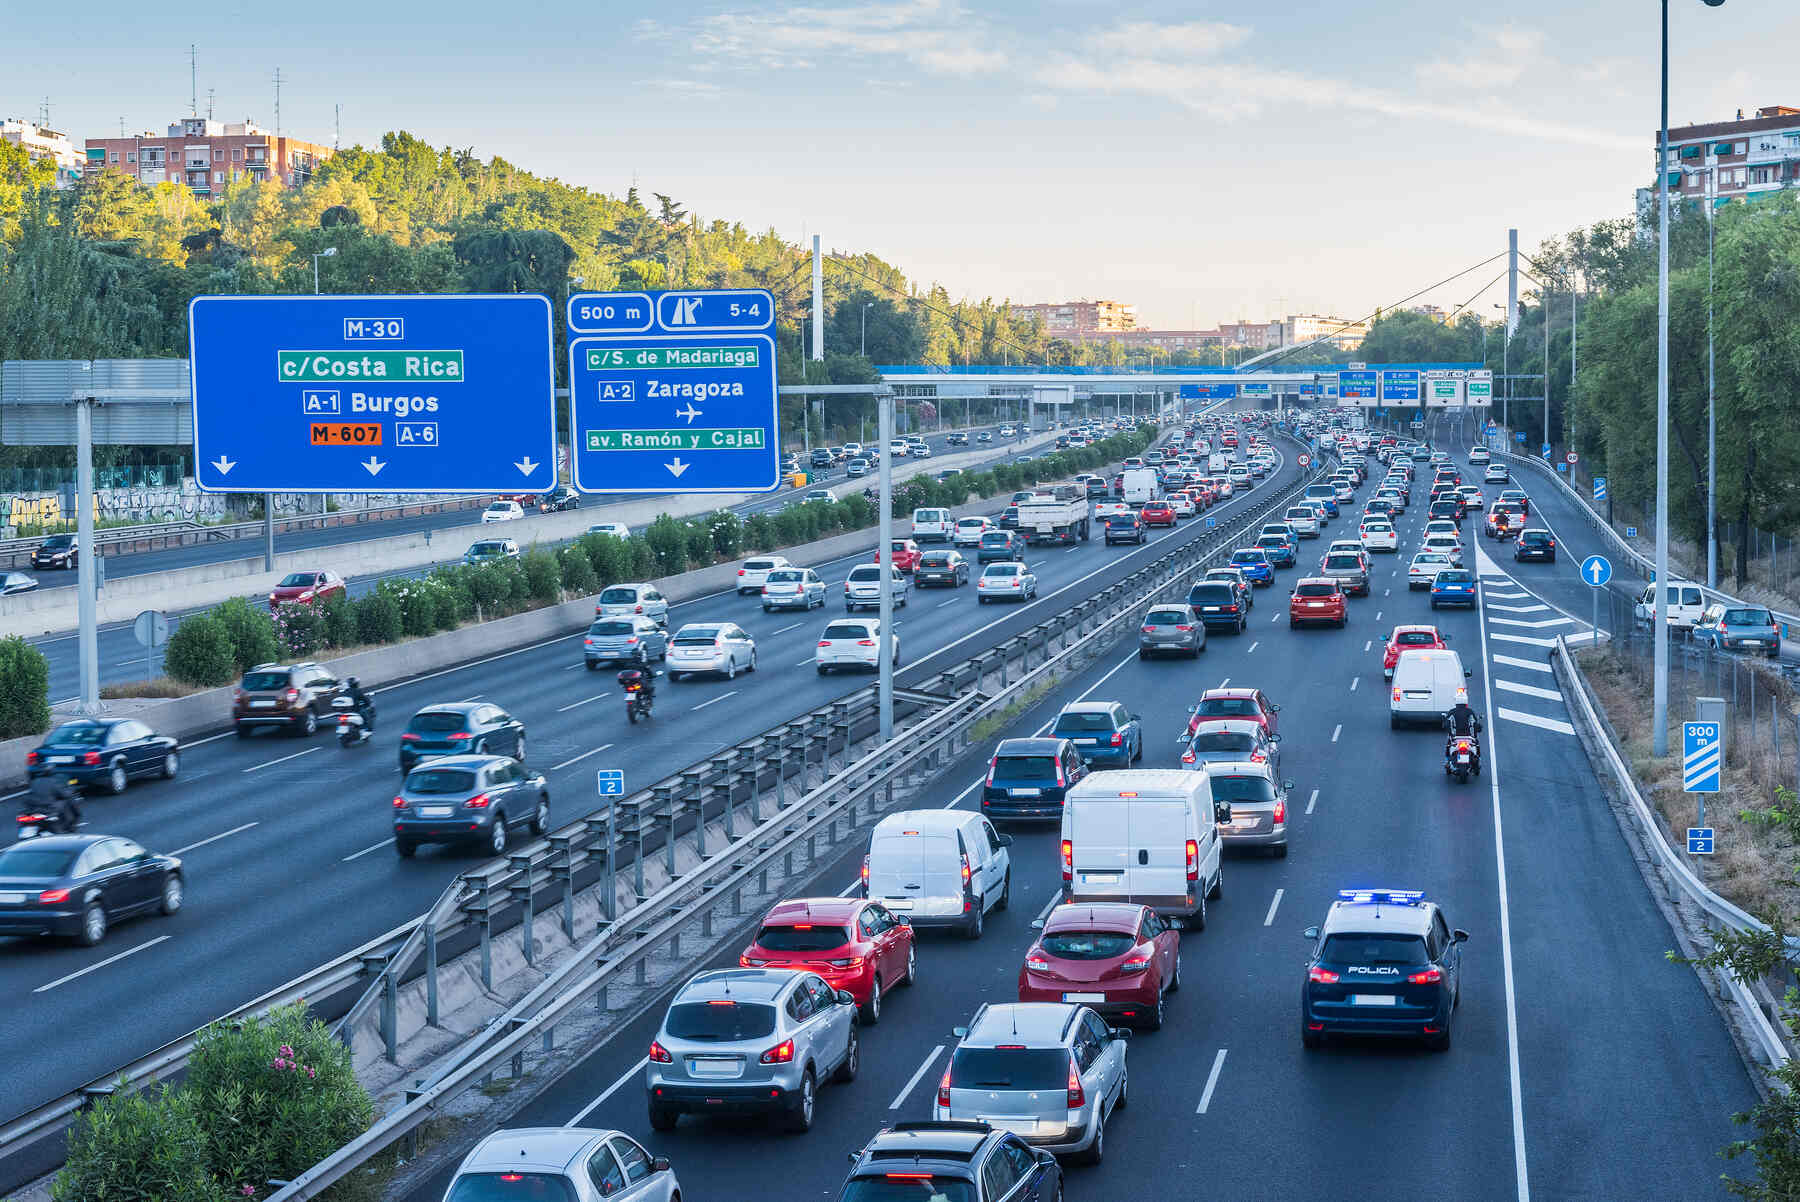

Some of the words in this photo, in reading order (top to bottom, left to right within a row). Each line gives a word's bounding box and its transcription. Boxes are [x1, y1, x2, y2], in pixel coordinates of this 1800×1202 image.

[580, 306, 616, 320] 500
[626, 307, 641, 320] m
[729, 303, 761, 317] 5-4
[347, 321, 401, 338] M-30
[282, 356, 387, 378] c/Costa
[405, 356, 460, 377] Rica
[589, 351, 630, 366] c/S.
[636, 350, 658, 365] de
[666, 349, 756, 368] Madariaga
[603, 384, 632, 399] A-2
[646, 380, 744, 401] Zaragoza
[306, 394, 338, 411] A-1
[351, 392, 439, 418] Burgos
[312, 425, 380, 443] M-607
[400, 425, 435, 442] A-6
[589, 435, 616, 447] av.
[621, 430, 683, 447] Ramón
[690, 435, 700, 449] y
[711, 430, 761, 448] Cajal
[1688, 726, 1714, 737] 300
[1697, 737, 1708, 746] m
[607, 782, 616, 793] 2
[1696, 841, 1705, 851] 2
